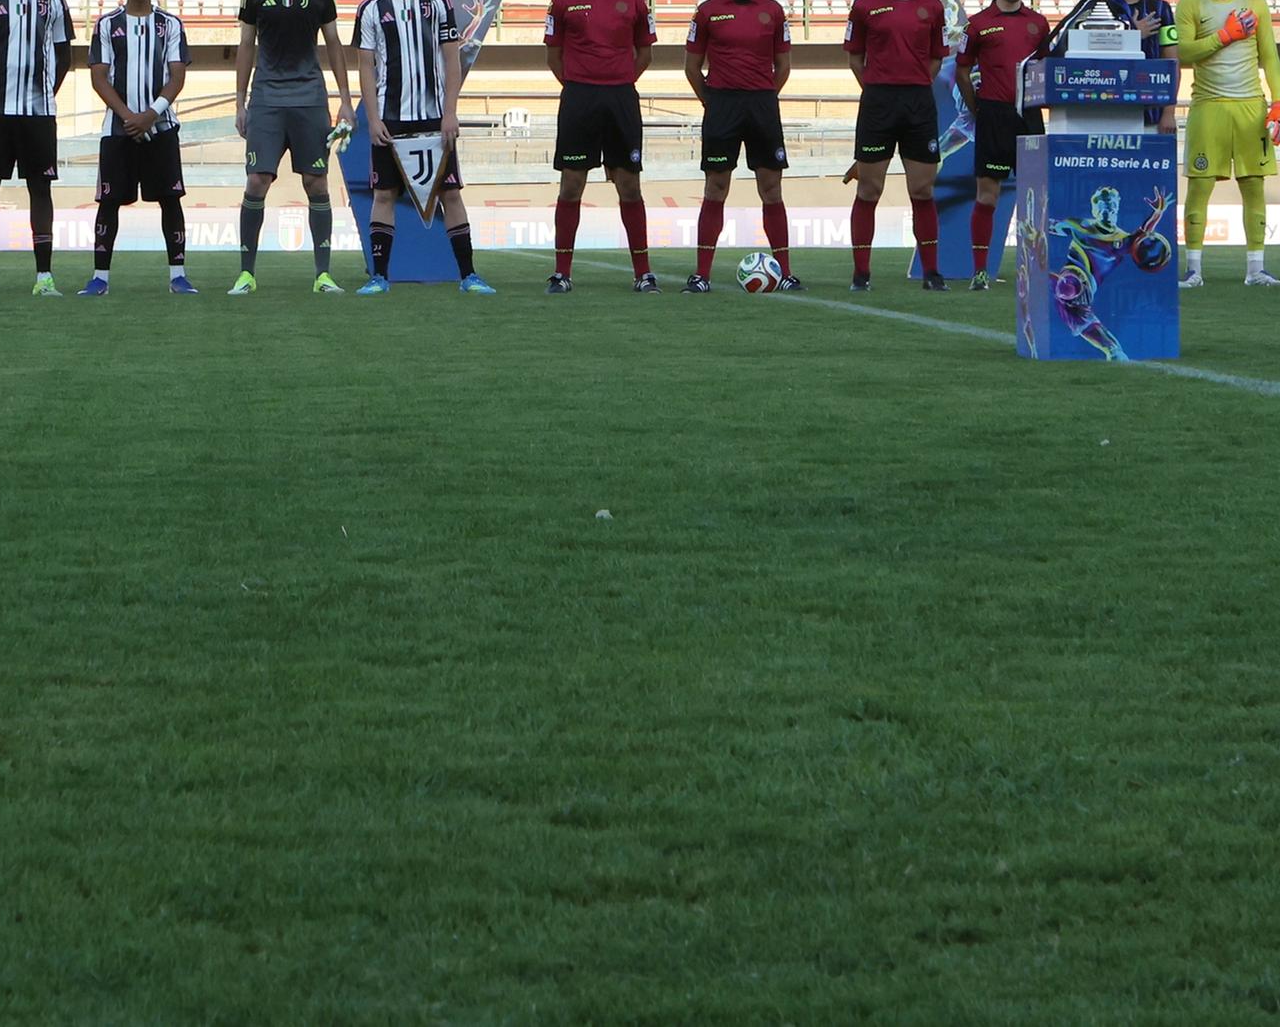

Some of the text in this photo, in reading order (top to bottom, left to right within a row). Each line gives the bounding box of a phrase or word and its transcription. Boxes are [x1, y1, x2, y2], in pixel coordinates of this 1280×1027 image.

[1084, 69, 1101, 77] SGS
[1149, 73, 1171, 84] TIM
[1068, 76, 1116, 86] CAMPIONATI
[1087, 134, 1142, 150] FINALI
[1054, 156, 1170, 170] UNDER 16 Serie A e B
[677, 219, 737, 246] TM
[790, 219, 852, 246] TIM
